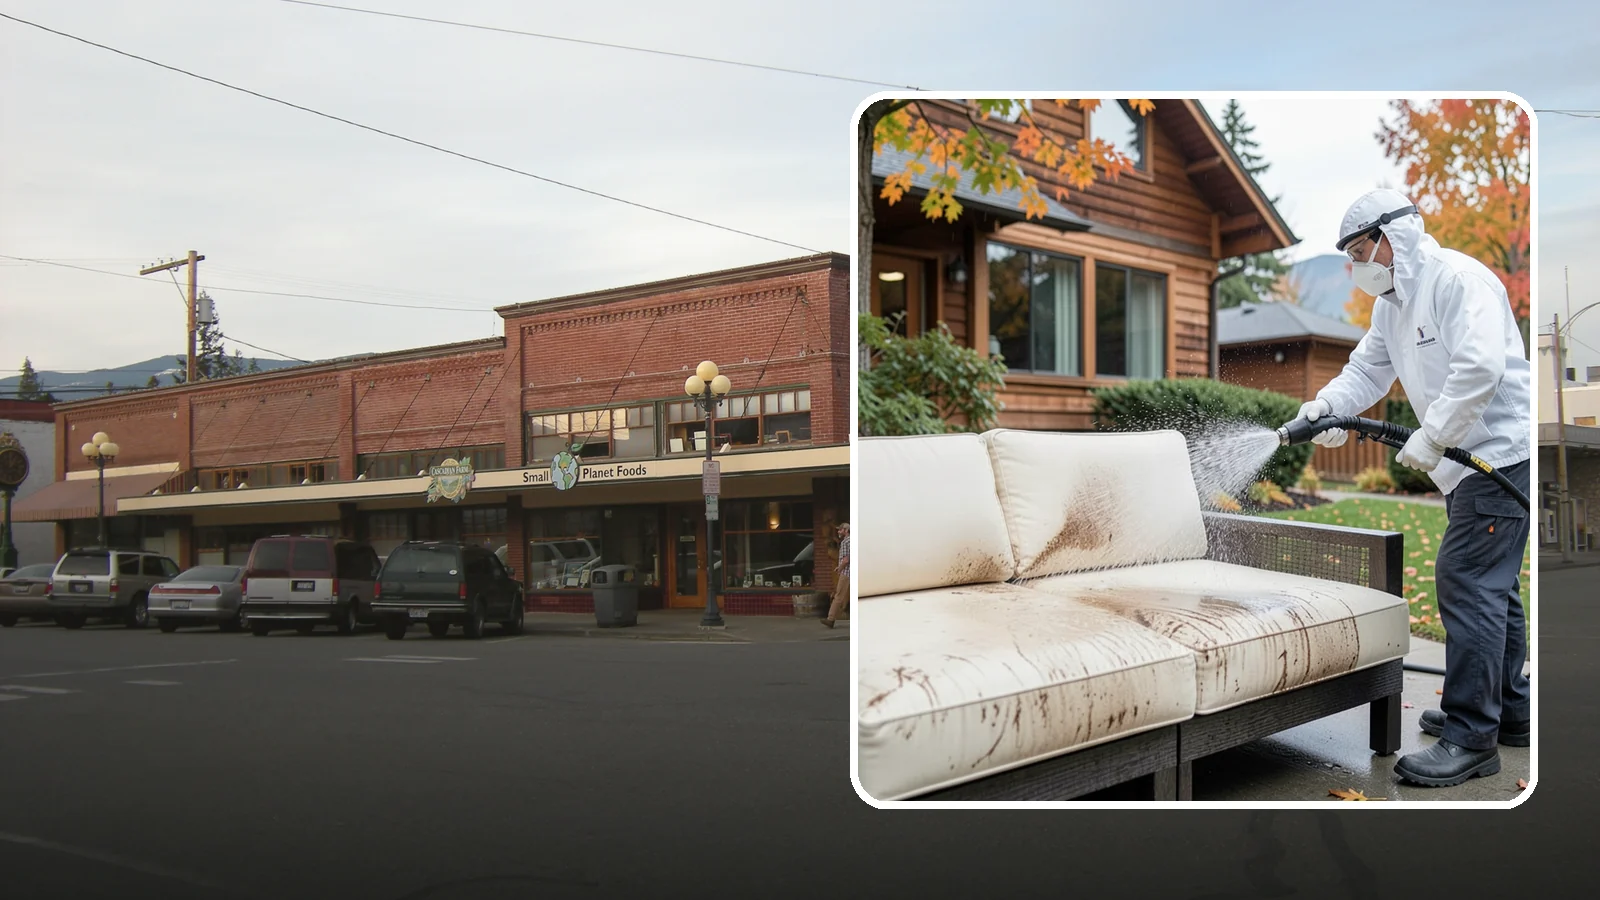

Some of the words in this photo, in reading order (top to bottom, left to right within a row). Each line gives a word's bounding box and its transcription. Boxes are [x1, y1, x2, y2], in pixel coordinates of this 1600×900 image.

[522, 471, 549, 483] Small
[583, 467, 614, 479] Planet
[616, 464, 647, 477] Foods
